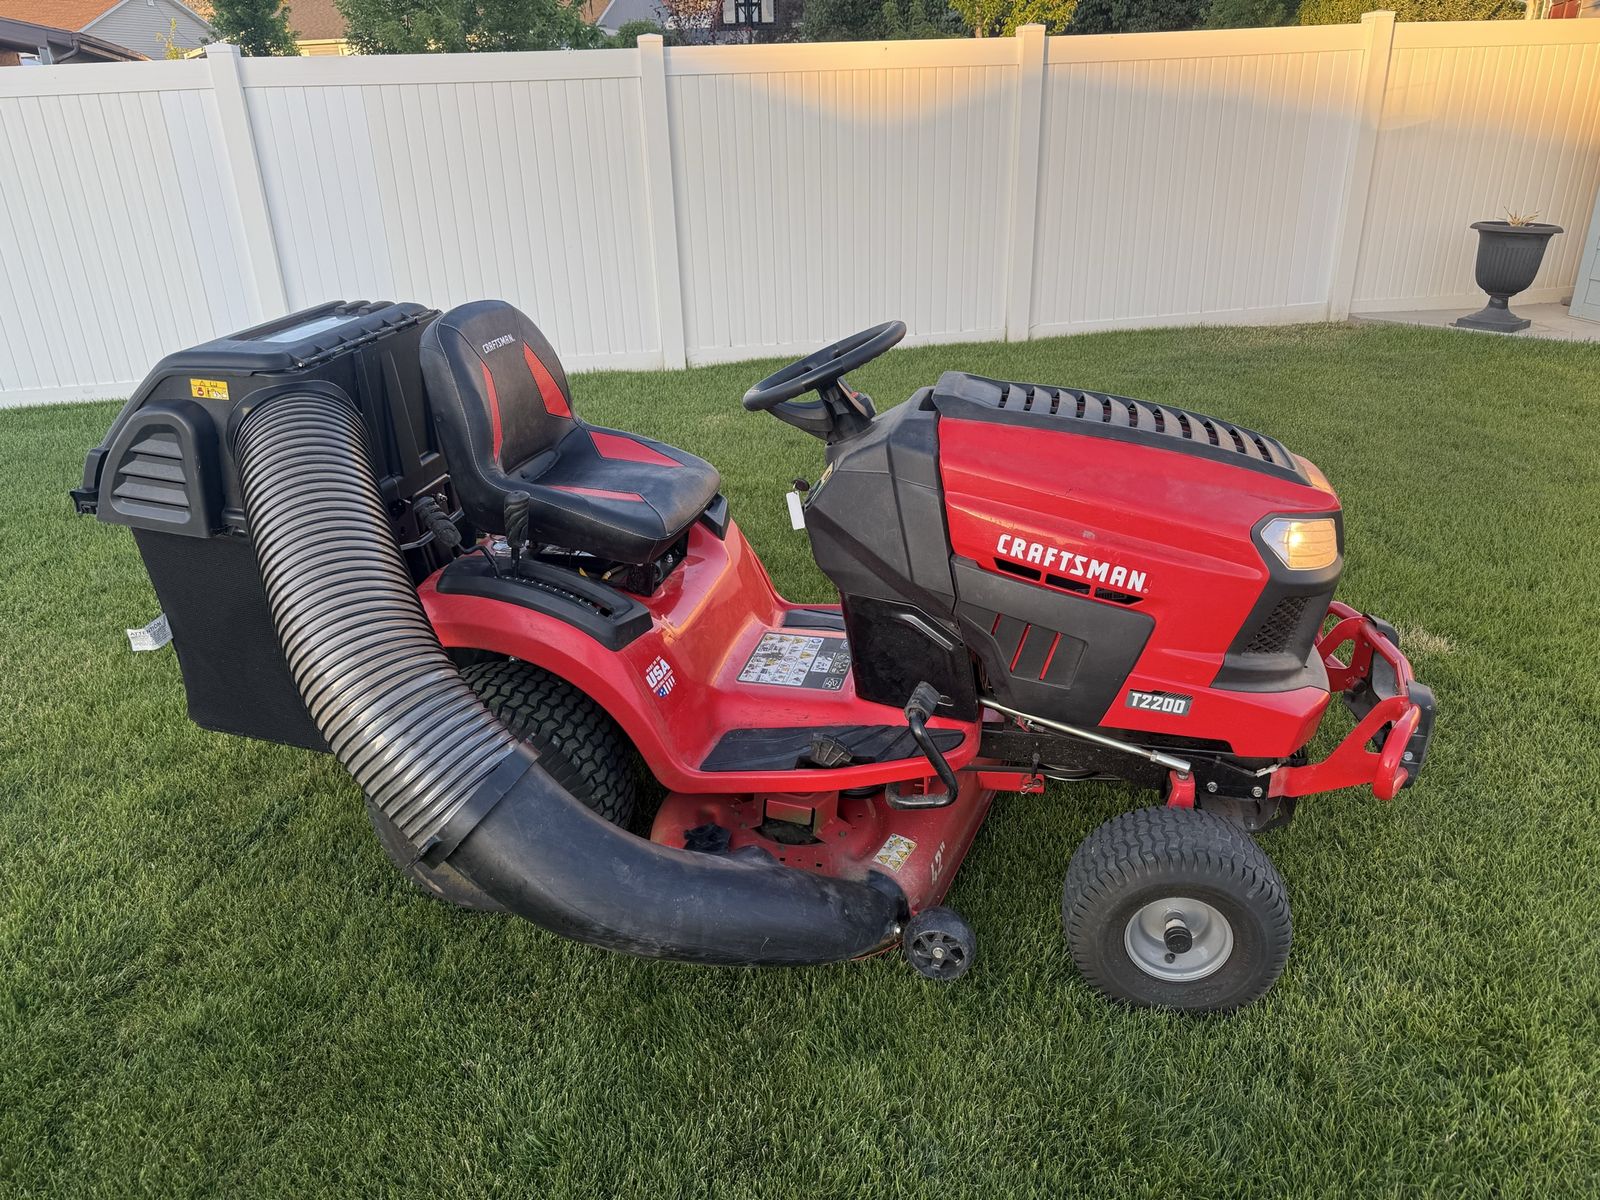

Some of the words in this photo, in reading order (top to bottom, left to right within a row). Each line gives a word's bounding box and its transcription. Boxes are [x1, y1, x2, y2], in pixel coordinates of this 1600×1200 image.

[482, 333, 514, 354] CRAFTSMAN
[996, 533, 1147, 593] CRAFTSMAN
[645, 658, 671, 689] USA
[1132, 692, 1186, 714] T2200
